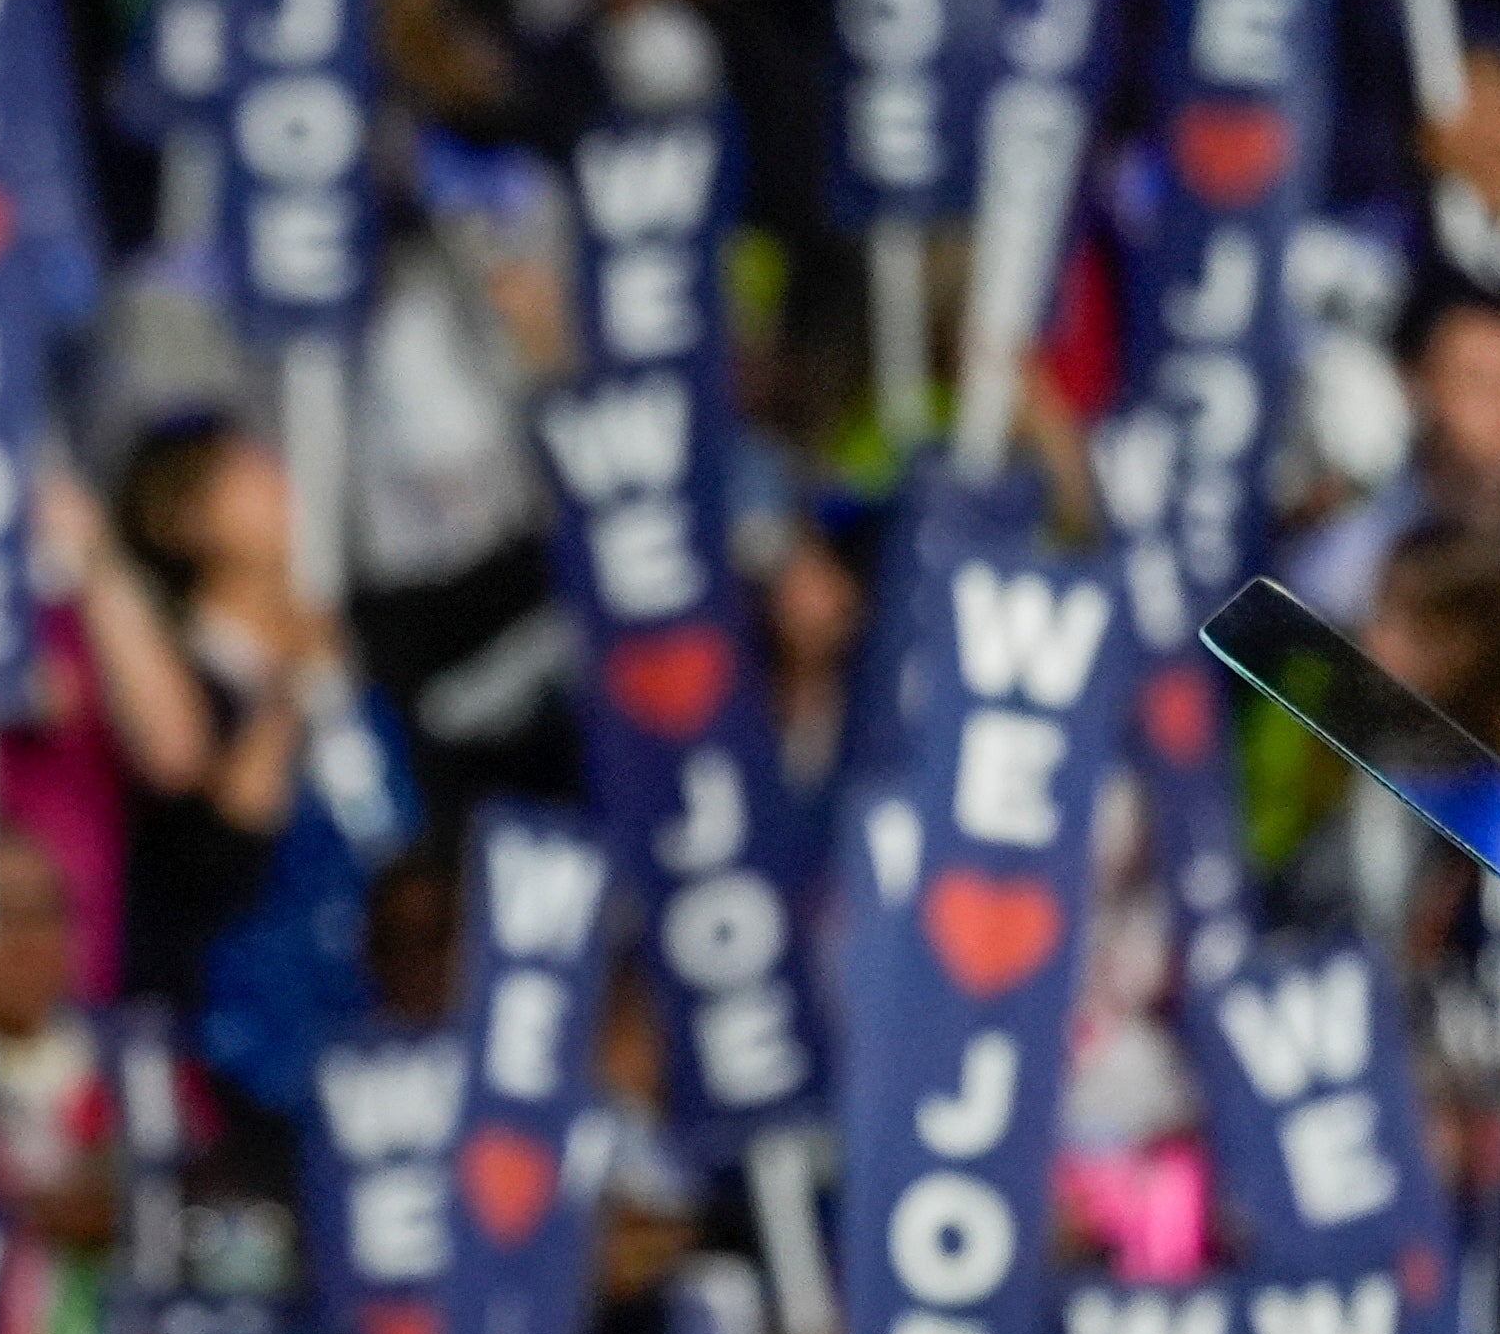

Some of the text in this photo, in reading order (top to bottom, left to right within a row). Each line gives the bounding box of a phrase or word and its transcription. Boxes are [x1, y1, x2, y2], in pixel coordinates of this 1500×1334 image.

[575, 129, 720, 369] WE
[1165, 247, 1267, 579] JOE
[540, 389, 790, 1107] WE JOE
[950, 570, 1117, 849] WE
[485, 830, 605, 1104] WE
[1213, 955, 1397, 1229] WE
[315, 1050, 470, 1284] WE
